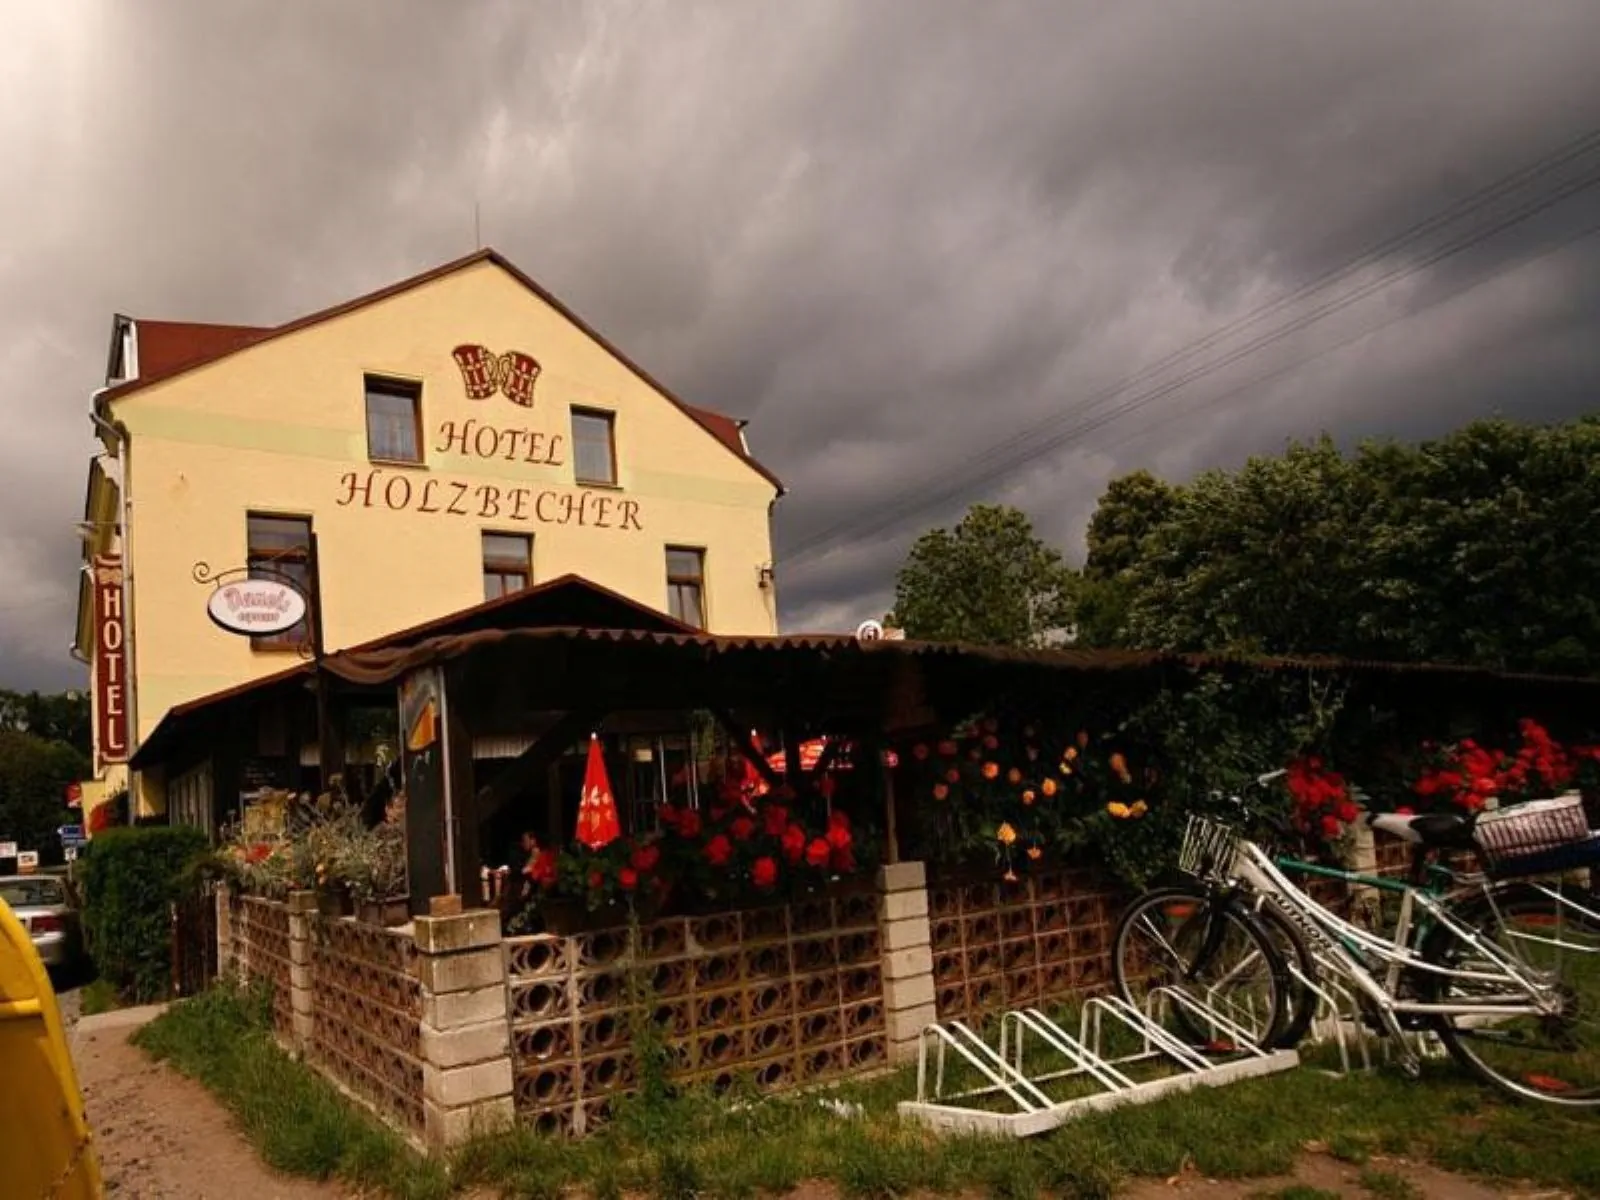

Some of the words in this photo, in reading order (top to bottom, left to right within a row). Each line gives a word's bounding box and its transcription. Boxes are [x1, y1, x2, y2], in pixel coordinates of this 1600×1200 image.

[436, 419, 564, 466] HOTEL
[336, 469, 644, 530] HOLZBECHER
[103, 588, 122, 749] HOTEL
[1267, 891, 1332, 949] AUTHOR
